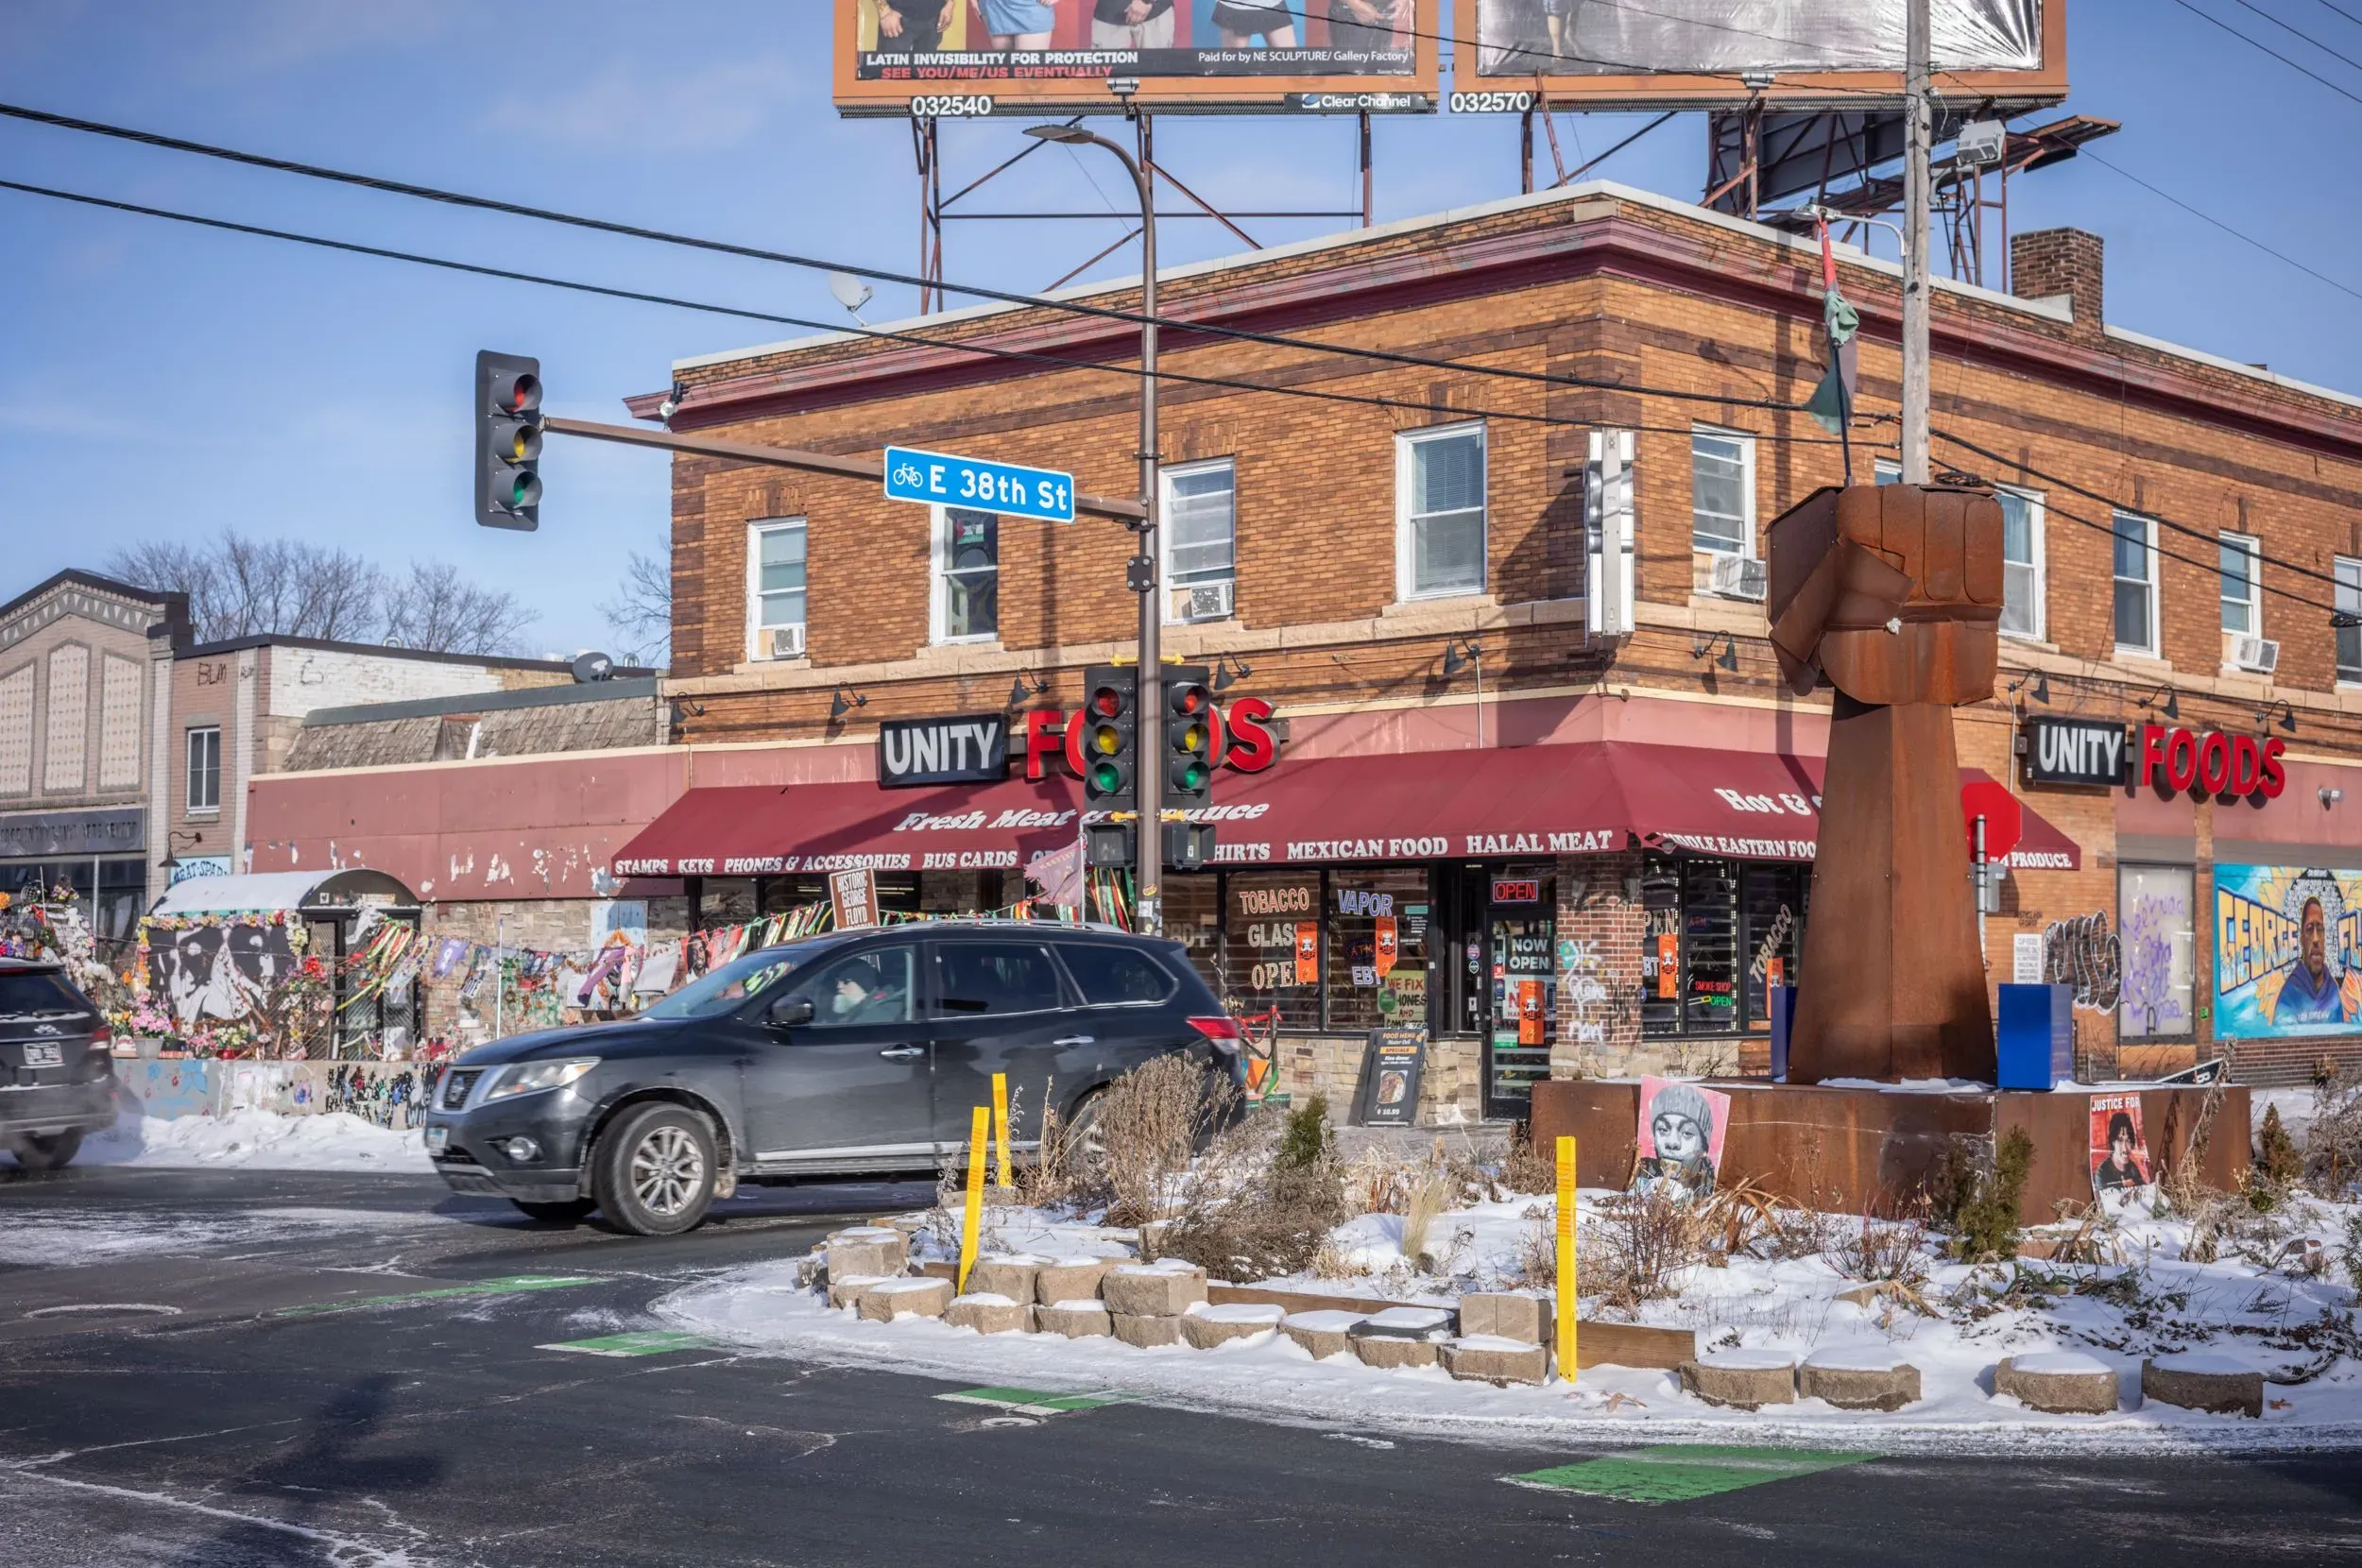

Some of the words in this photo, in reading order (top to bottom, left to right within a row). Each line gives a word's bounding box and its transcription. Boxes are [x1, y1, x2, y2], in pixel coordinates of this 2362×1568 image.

[866, 53, 909, 65] LATIN
[914, 53, 1005, 65] INVISIBILITY
[1011, 53, 1040, 64] FOR
[1045, 51, 1138, 64] PROTECTION
[1198, 52, 1220, 62] Paid
[1222, 52, 1237, 61] for
[1238, 52, 1252, 64] by
[1253, 52, 1268, 61] NE
[1269, 51, 1331, 61] SCULPTURE/
[1333, 51, 1368, 64] Gallery
[1370, 50, 1409, 63] Factory
[881, 67, 911, 78] SEE
[916, 67, 1008, 78] YOU/ME/US
[1014, 66, 1112, 77] EVENTUALLY
[912, 96, 991, 115] 032540
[1322, 96, 1357, 108] Clear
[1359, 95, 1411, 108] Channel
[1450, 94, 1532, 111] 032570
[930, 464, 947, 493] E
[960, 469, 1026, 505] 38th
[1038, 481, 1067, 511] St
[197, 662, 227, 686] BLM
[884, 723, 998, 775] UNITY
[2039, 724, 2123, 776] UNITY
[2140, 724, 2285, 798] FOODS
[1714, 789, 1785, 814] Hot
[1778, 793, 1811, 815] &
[893, 810, 987, 831] Fresh
[987, 809, 1077, 828] Meat
[1287, 839, 1384, 860] MEXICAN
[1389, 836, 1448, 857] FOOD
[1466, 832, 1544, 854] HALAL
[1549, 830, 1613, 851] MEAT
[1717, 837, 1786, 857] EASTERN
[615, 858, 669, 874] STAMPS
[677, 858, 715, 873] KEYS
[724, 857, 782, 873] PHONES
[785, 856, 799, 871] &
[802, 852, 911, 871] ACCESSORIES
[922, 851, 955, 869] BUS
[959, 850, 1018, 867] CARDS
[2011, 851, 2073, 868] PRODUCE
[836, 870, 867, 893] HISTORIC
[1496, 883, 1535, 900] OPEN
[841, 888, 868, 908] GEORGE
[1240, 887, 1310, 914] TOBACCO
[1338, 889, 1394, 917] VAPOR
[846, 906, 868, 926] FLOYD
[1513, 939, 1548, 952] NOW
[1749, 903, 1792, 983] TOBACCO
[2217, 889, 2300, 995] GEORGE
[1510, 956, 1549, 969] OPEN
[1386, 977, 1401, 990] WE
[1404, 978, 1425, 991] FIX
[1695, 980, 1715, 991] SMOKE
[1715, 980, 1731, 992] SHOP
[1710, 996, 1732, 1006] OPEN
[2092, 1098, 2123, 1112] JUSTICE
[2125, 1097, 2141, 1108] FOR
